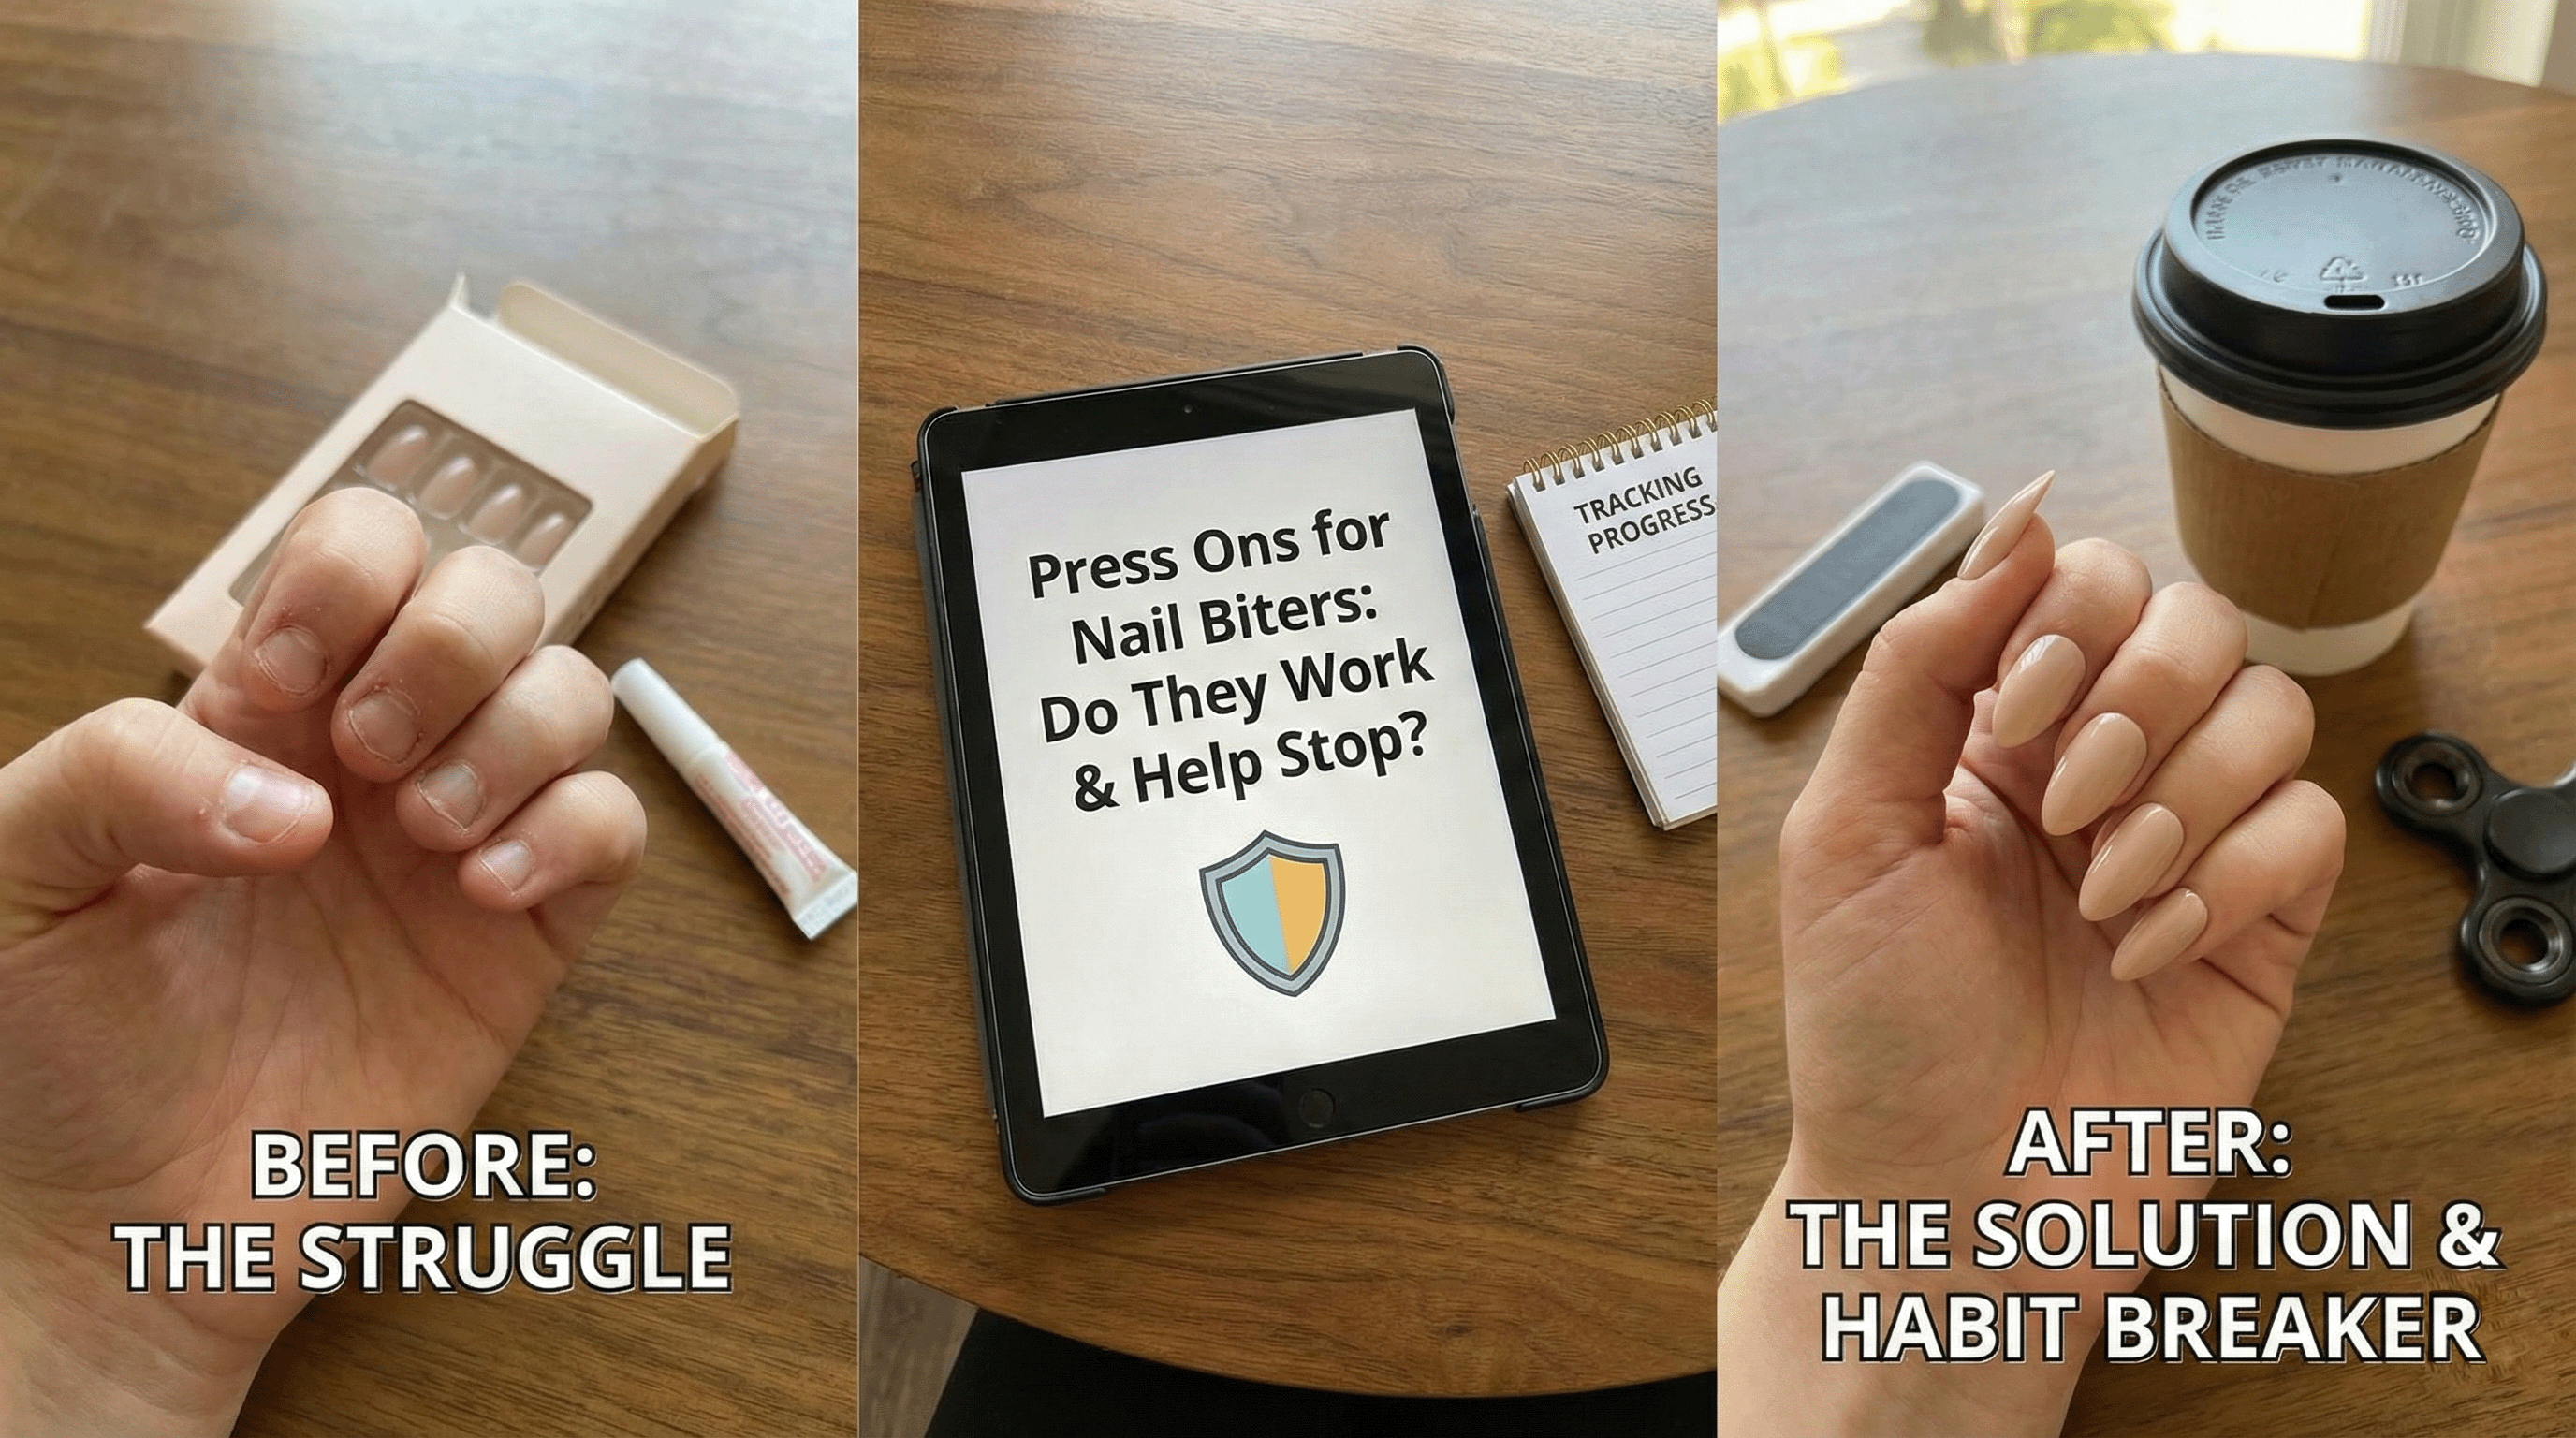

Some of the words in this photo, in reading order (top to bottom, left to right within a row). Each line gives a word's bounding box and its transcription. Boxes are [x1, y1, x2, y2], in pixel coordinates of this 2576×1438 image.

[1573, 466, 1703, 524] TRACKING
[1588, 494, 1716, 555] PROGRESS
[1029, 546, 1178, 599] Press
[1193, 529, 1300, 573] Ons
[1311, 508, 1390, 556] for
[1071, 602, 1184, 665] Nail
[1199, 585, 1377, 645] Biters:
[1040, 696, 1118, 743] Do
[1130, 673, 1267, 726] They
[1279, 637, 1435, 702] Work
[1075, 764, 1120, 812] &
[1132, 741, 1262, 803] Help
[1277, 710, 1427, 778] Stop?
